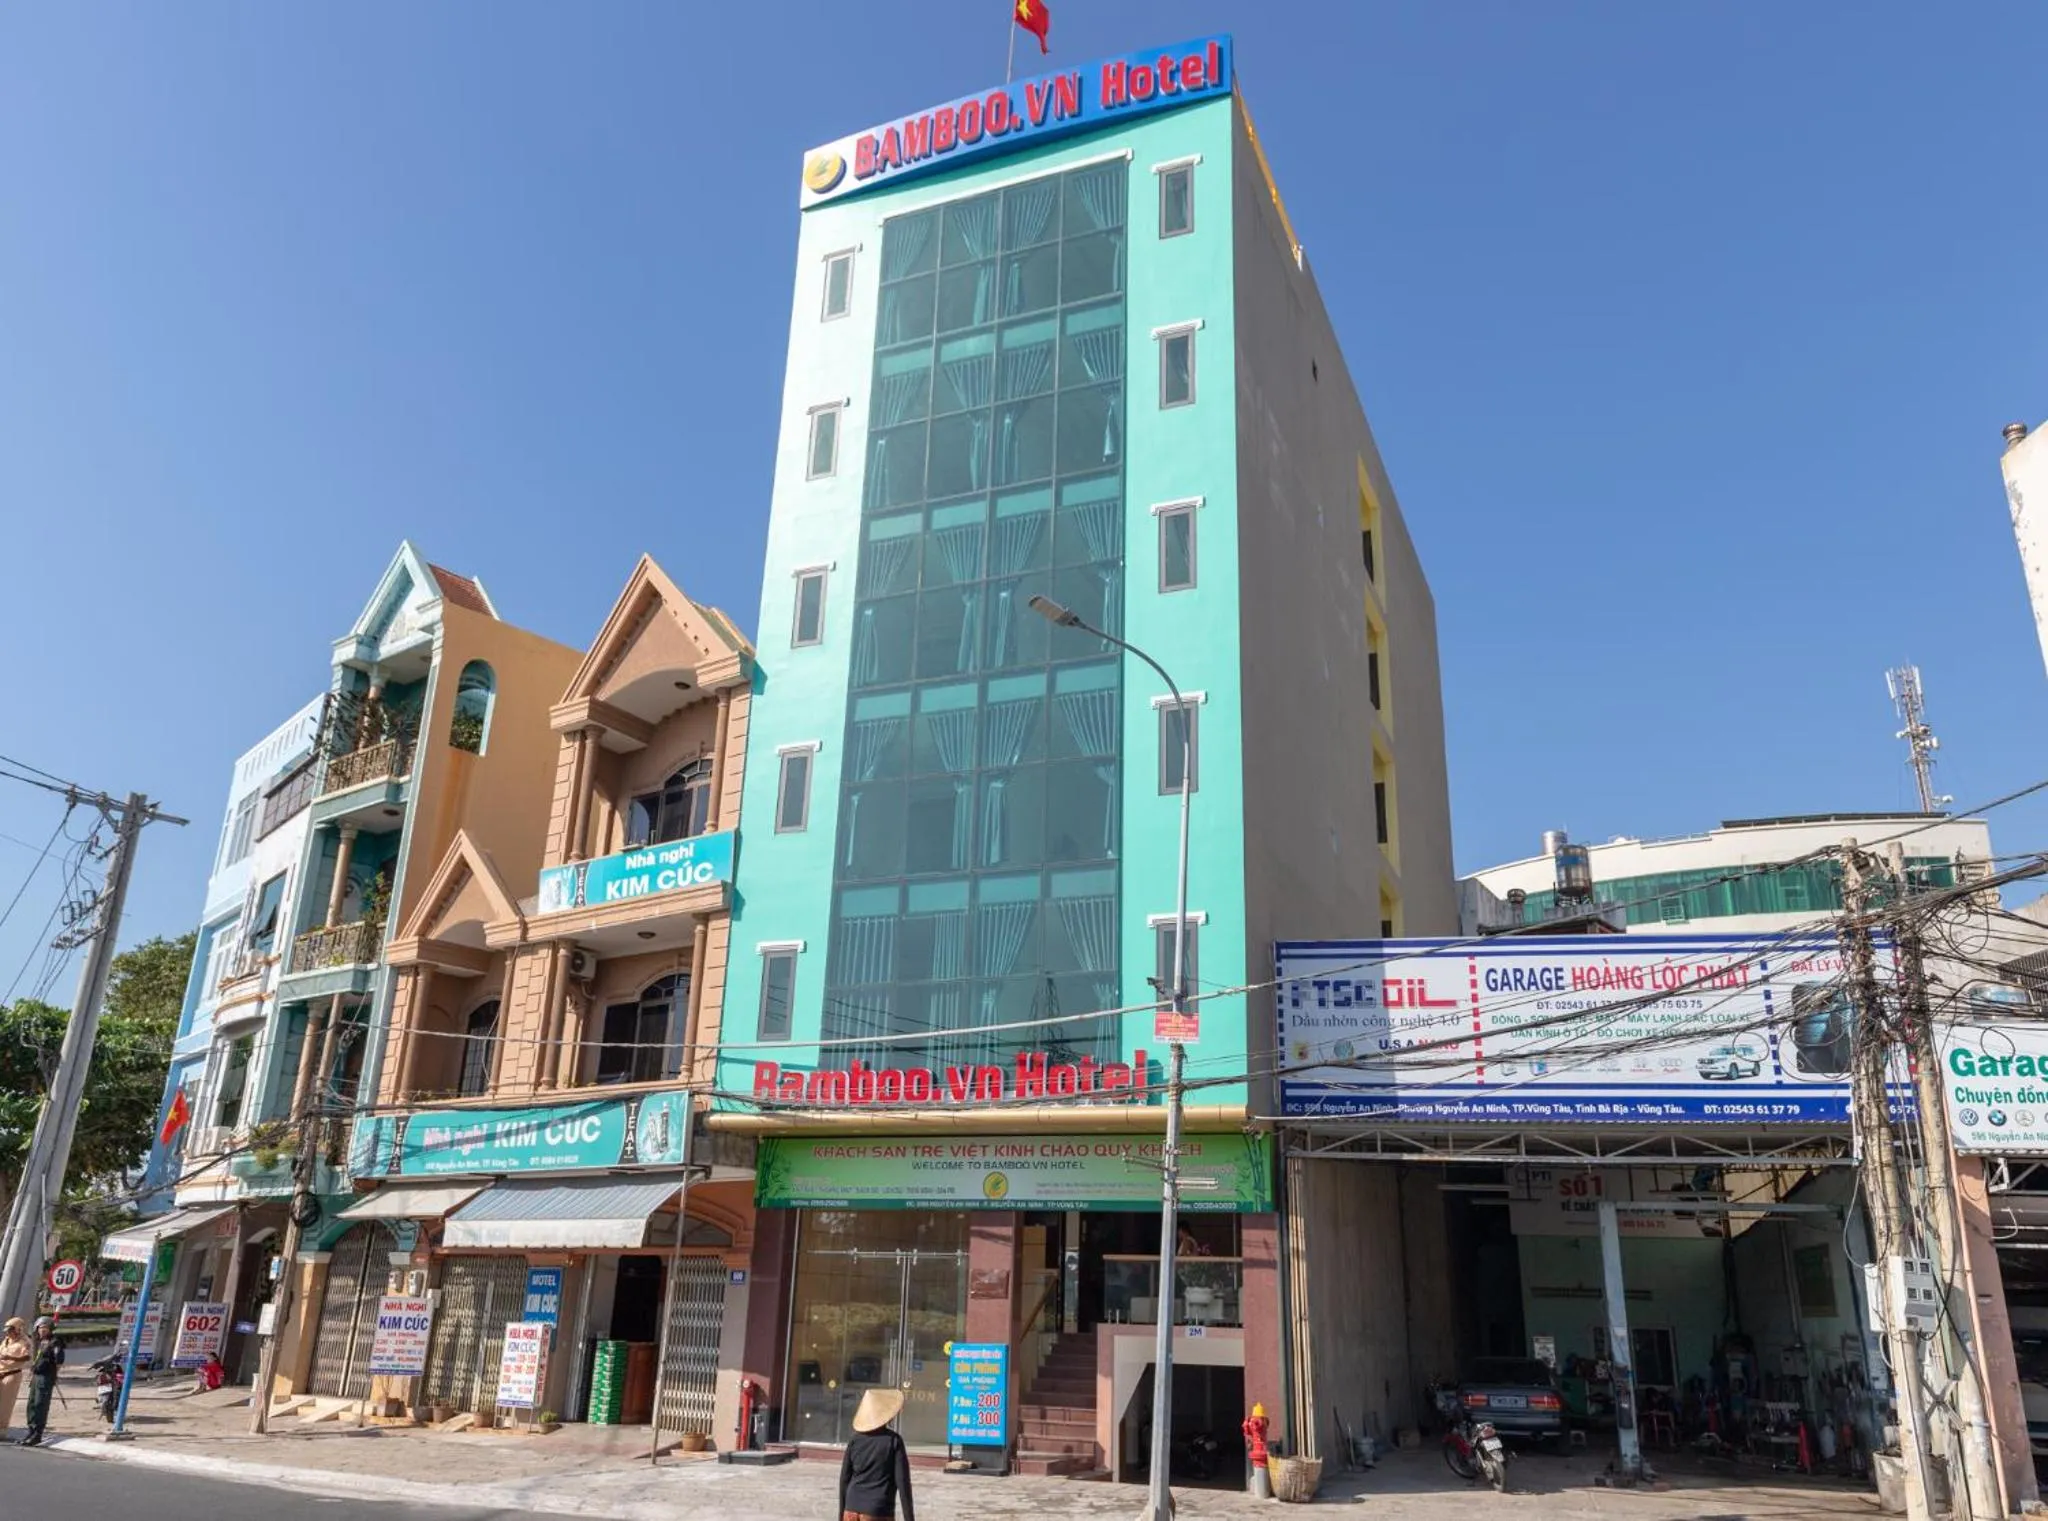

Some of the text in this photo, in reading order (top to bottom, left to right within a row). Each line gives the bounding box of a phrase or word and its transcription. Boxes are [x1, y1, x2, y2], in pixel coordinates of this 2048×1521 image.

[854, 41, 1219, 180] BAMBOO.VN Hotel
[625, 851, 657, 870] Nhà
[606, 860, 715, 900] KIM CÚC
[1485, 967, 1566, 992] GARAGE
[1571, 957, 1644, 991] HOÀNG
[1015, 1048, 1148, 1102] Hotel
[1359, 1103, 1371, 1113] An
[1435, 1101, 1469, 1115] Nguyễn
[1472, 1103, 1484, 1113] An
[1486, 1103, 1510, 1114] Ninh,
[1513, 1103, 1551, 1115] TP.Vũng
[1553, 1103, 1573, 1114] Tàu,
[1598, 1103, 1610, 1113] Bà
[1613, 1103, 1628, 1115] Rịa
[1637, 1103, 1662, 1115] Vũng
[1663, 1103, 1685, 1114] Tàu.
[1704, 1104, 1800, 1114] ĐT: 02543 61 37 79
[494, 1119, 537, 1148] KIM
[911, 1160, 963, 1171] WELCOME
[967, 1160, 982, 1171] TO
[1051, 1159, 1086, 1170] HOTEL
[56, 1267, 75, 1285] 50
[186, 1316, 221, 1331] 602
[379, 1313, 428, 1330] KIM CÚC
[977, 1393, 1001, 1409] 200
[977, 1411, 1001, 1426] 300
